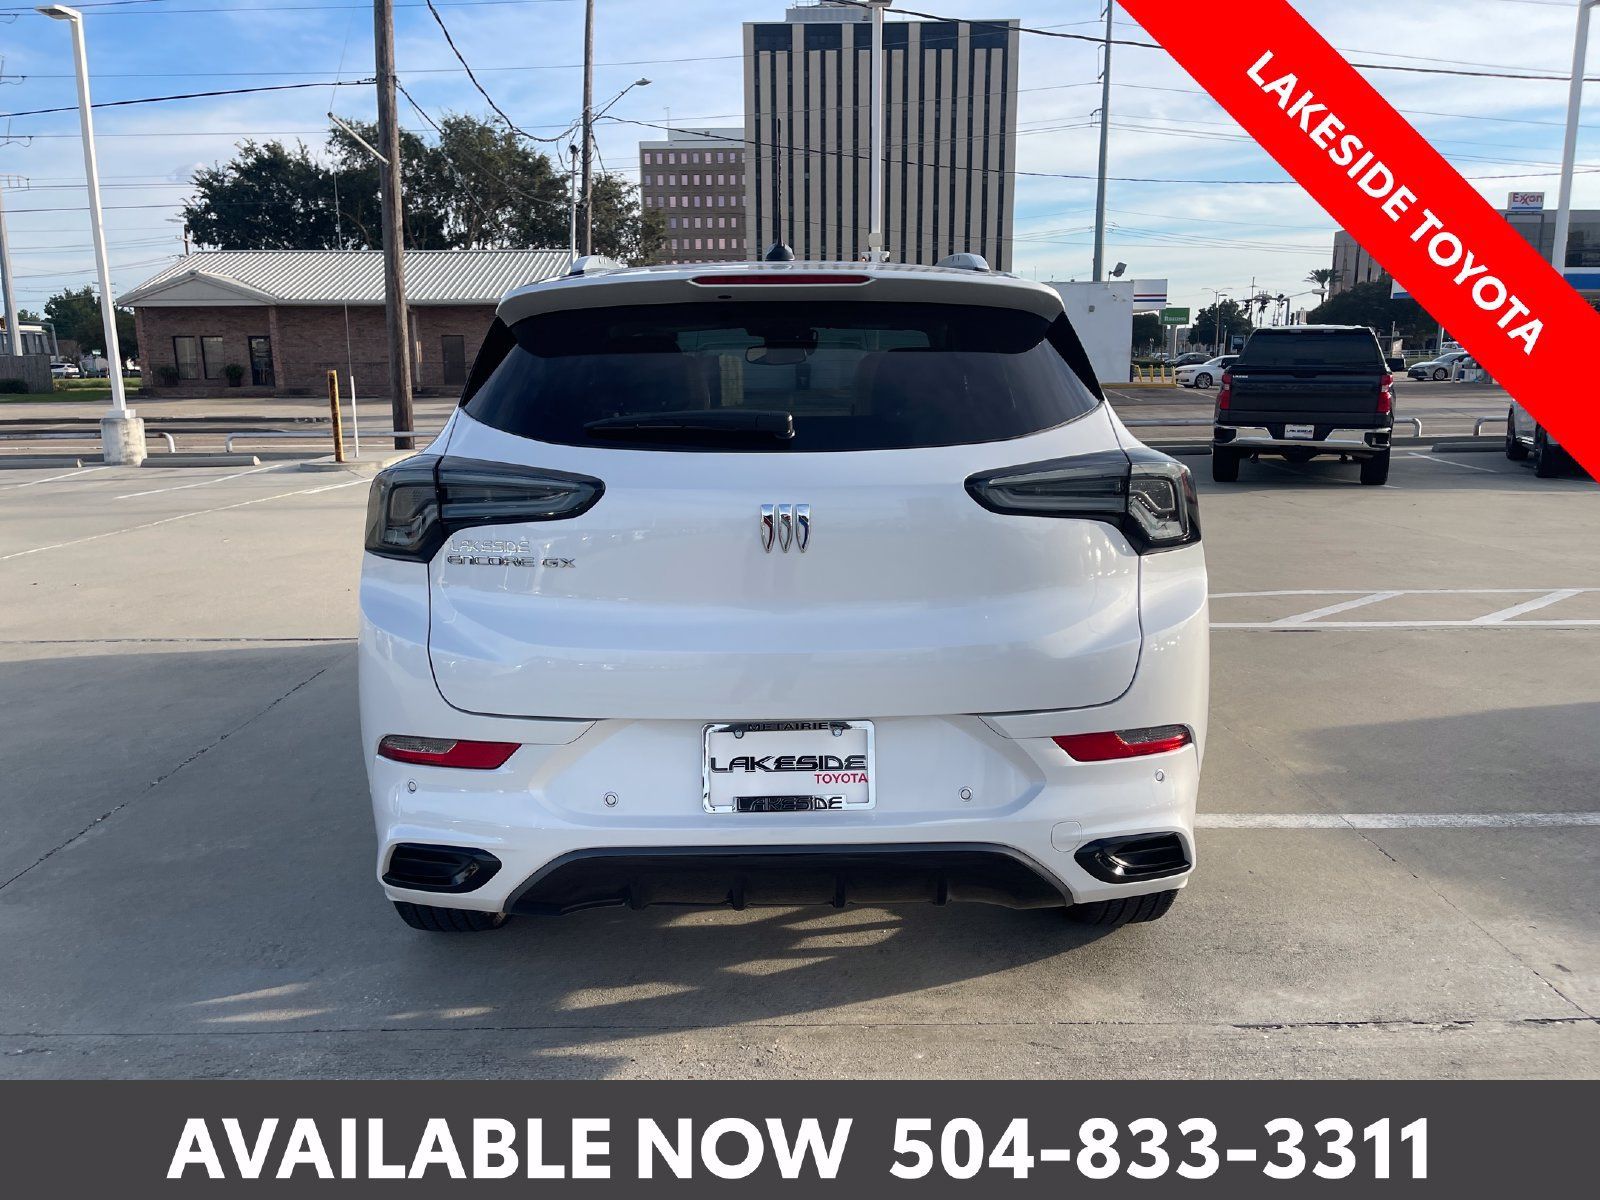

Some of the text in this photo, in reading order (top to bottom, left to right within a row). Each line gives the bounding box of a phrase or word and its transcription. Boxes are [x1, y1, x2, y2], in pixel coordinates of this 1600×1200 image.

[1512, 192, 1543, 206] Exxon
[451, 539, 530, 553] LAKESIDE
[447, 555, 576, 569] ENCORE GX
[747, 722, 830, 732] METAIRIE
[710, 754, 868, 773] LAKESIDE
[814, 773, 869, 784] TOYOTA
[736, 795, 843, 811] LAKESIDE
